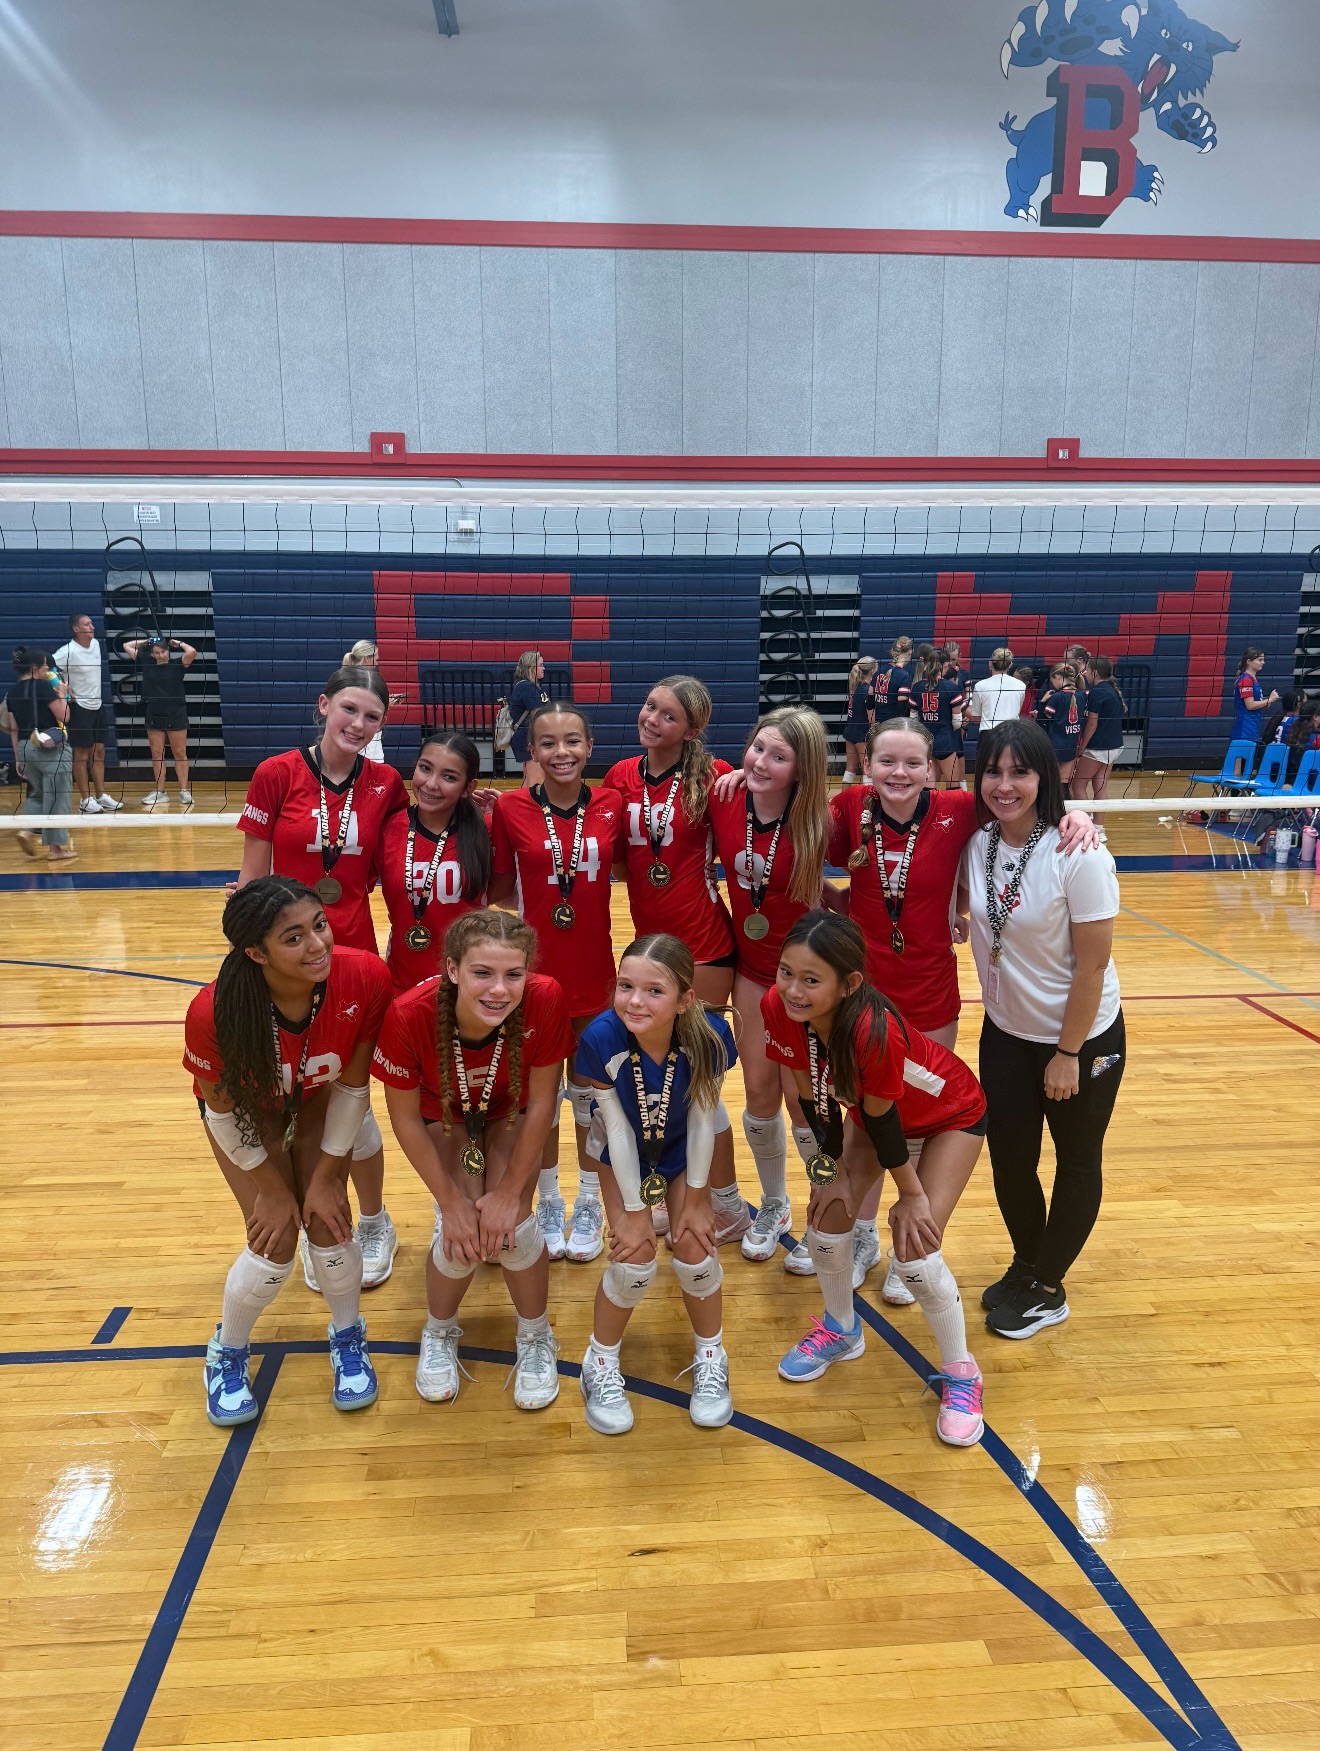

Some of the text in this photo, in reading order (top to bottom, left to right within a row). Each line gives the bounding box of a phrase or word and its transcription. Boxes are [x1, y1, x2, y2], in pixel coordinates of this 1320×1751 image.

[1040, 64, 1140, 227] B
[922, 692, 940, 712] 15
[339, 788, 354, 838] CHAMPION
[659, 780, 680, 828] CHAMPION
[306, 809, 364, 855] 11
[546, 816, 563, 866] CHAMPION
[569, 816, 584, 868] CHAMPION
[764, 823, 781, 876] CHAMPION
[405, 840, 414, 891] CHAMPION
[412, 861, 463, 906] 30
[425, 838, 446, 889] CHAMPION
[544, 837, 601, 885] 14
[734, 849, 766, 891] 9
[876, 834, 889, 888] CHAMPION
[884, 850, 913, 897] 7
[899, 833, 916, 889] CHAMPION
[452, 1040, 470, 1102] CHAMPION
[483, 1037, 504, 1100] CHAMPION
[808, 1036, 819, 1102] CHAMPION
[820, 1064, 830, 1116] CHAMPIO
[633, 1066, 651, 1128] CHAMPION
[658, 1063, 676, 1128] CHAMPION
